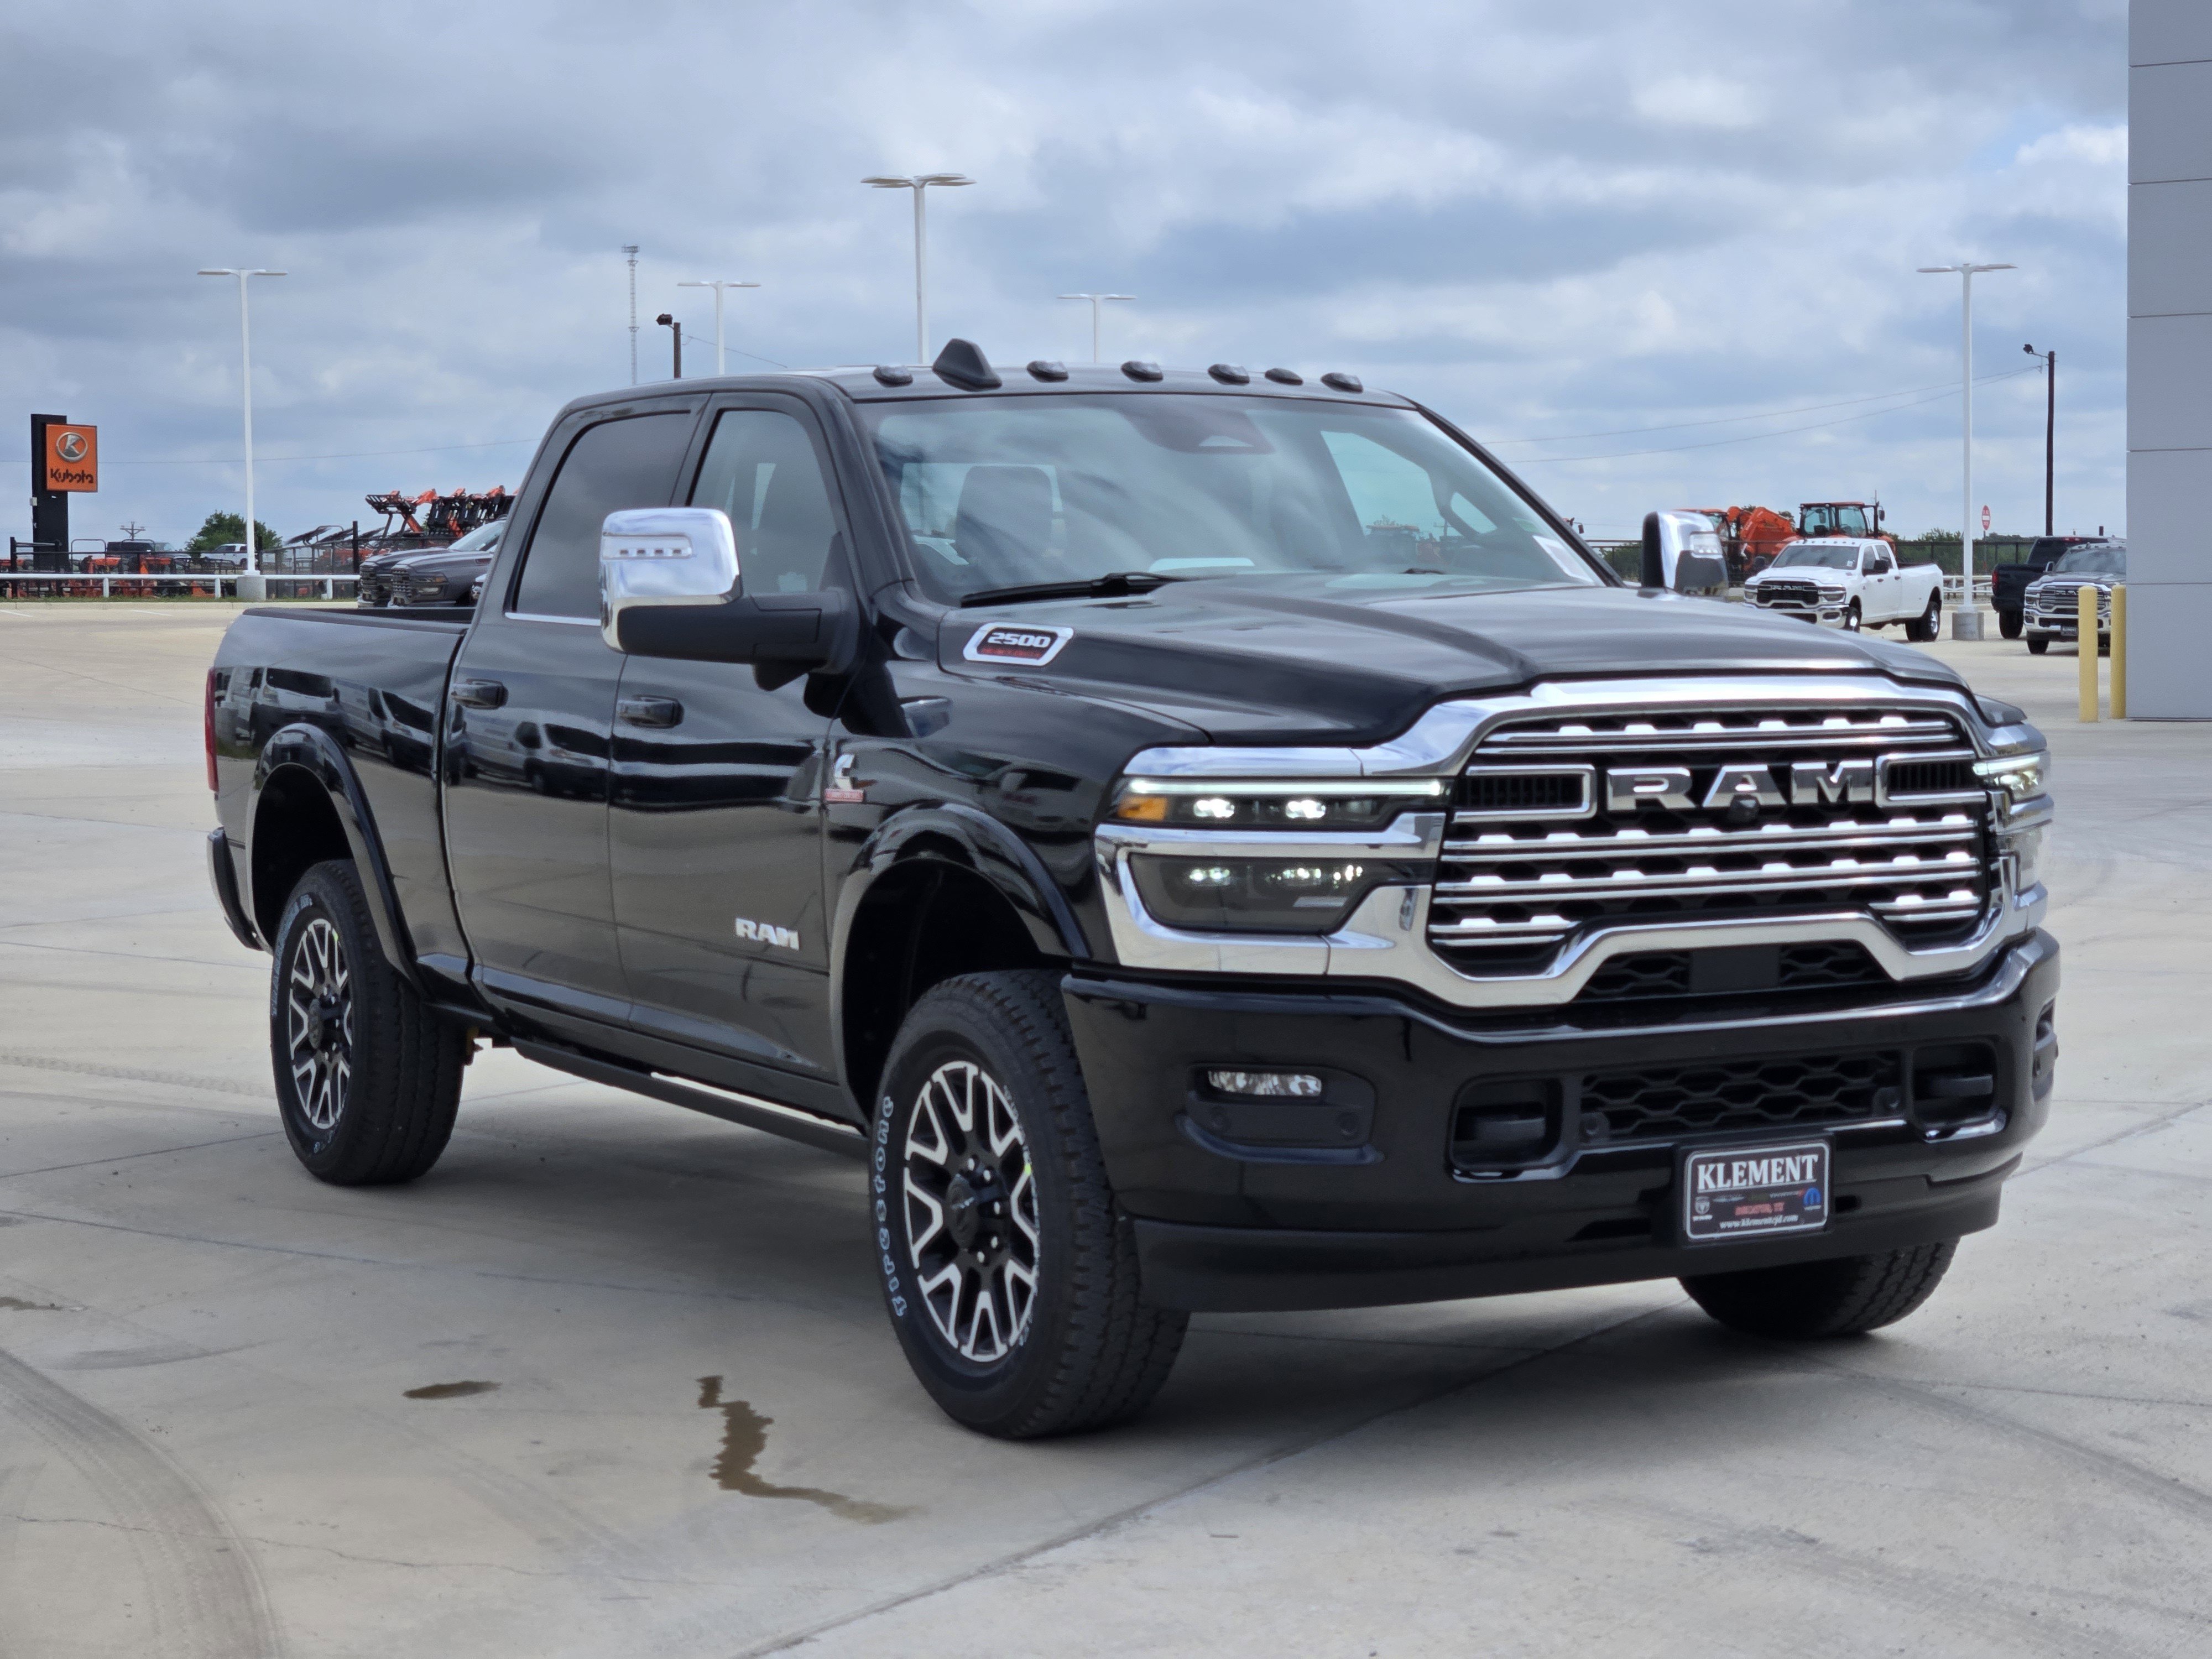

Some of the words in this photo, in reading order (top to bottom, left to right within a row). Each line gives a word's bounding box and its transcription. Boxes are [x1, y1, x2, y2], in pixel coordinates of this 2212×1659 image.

[50, 468, 94, 484] Kubota
[988, 632, 1051, 648] 2500
[1607, 760, 1874, 811] RAM
[735, 917, 800, 951] RAM
[1697, 1154, 1818, 1190] KLEMENT
